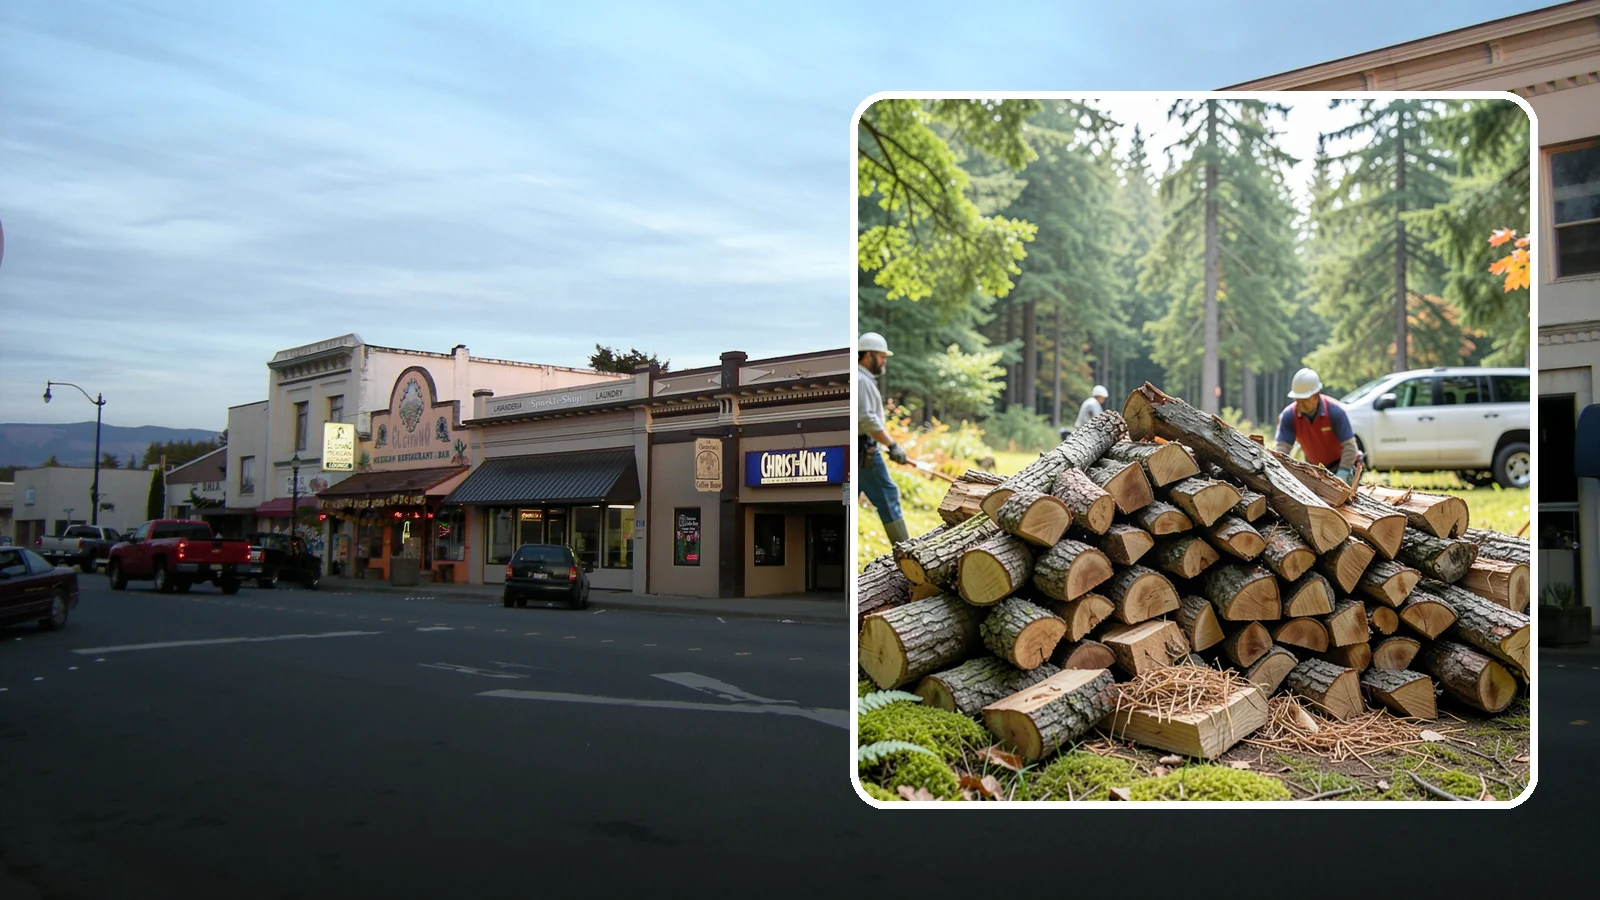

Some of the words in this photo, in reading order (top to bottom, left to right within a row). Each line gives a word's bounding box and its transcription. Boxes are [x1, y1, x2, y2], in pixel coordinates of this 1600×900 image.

[493, 401, 522, 413] LAVANDERIA
[595, 389, 623, 400] LAUNDRY
[373, 454, 396, 464] MEXICAN
[397, 451, 433, 462] RESTAURANT
[437, 450, 450, 459] BAR
[761, 452, 797, 477] CHRIST
[799, 450, 827, 476] KING
